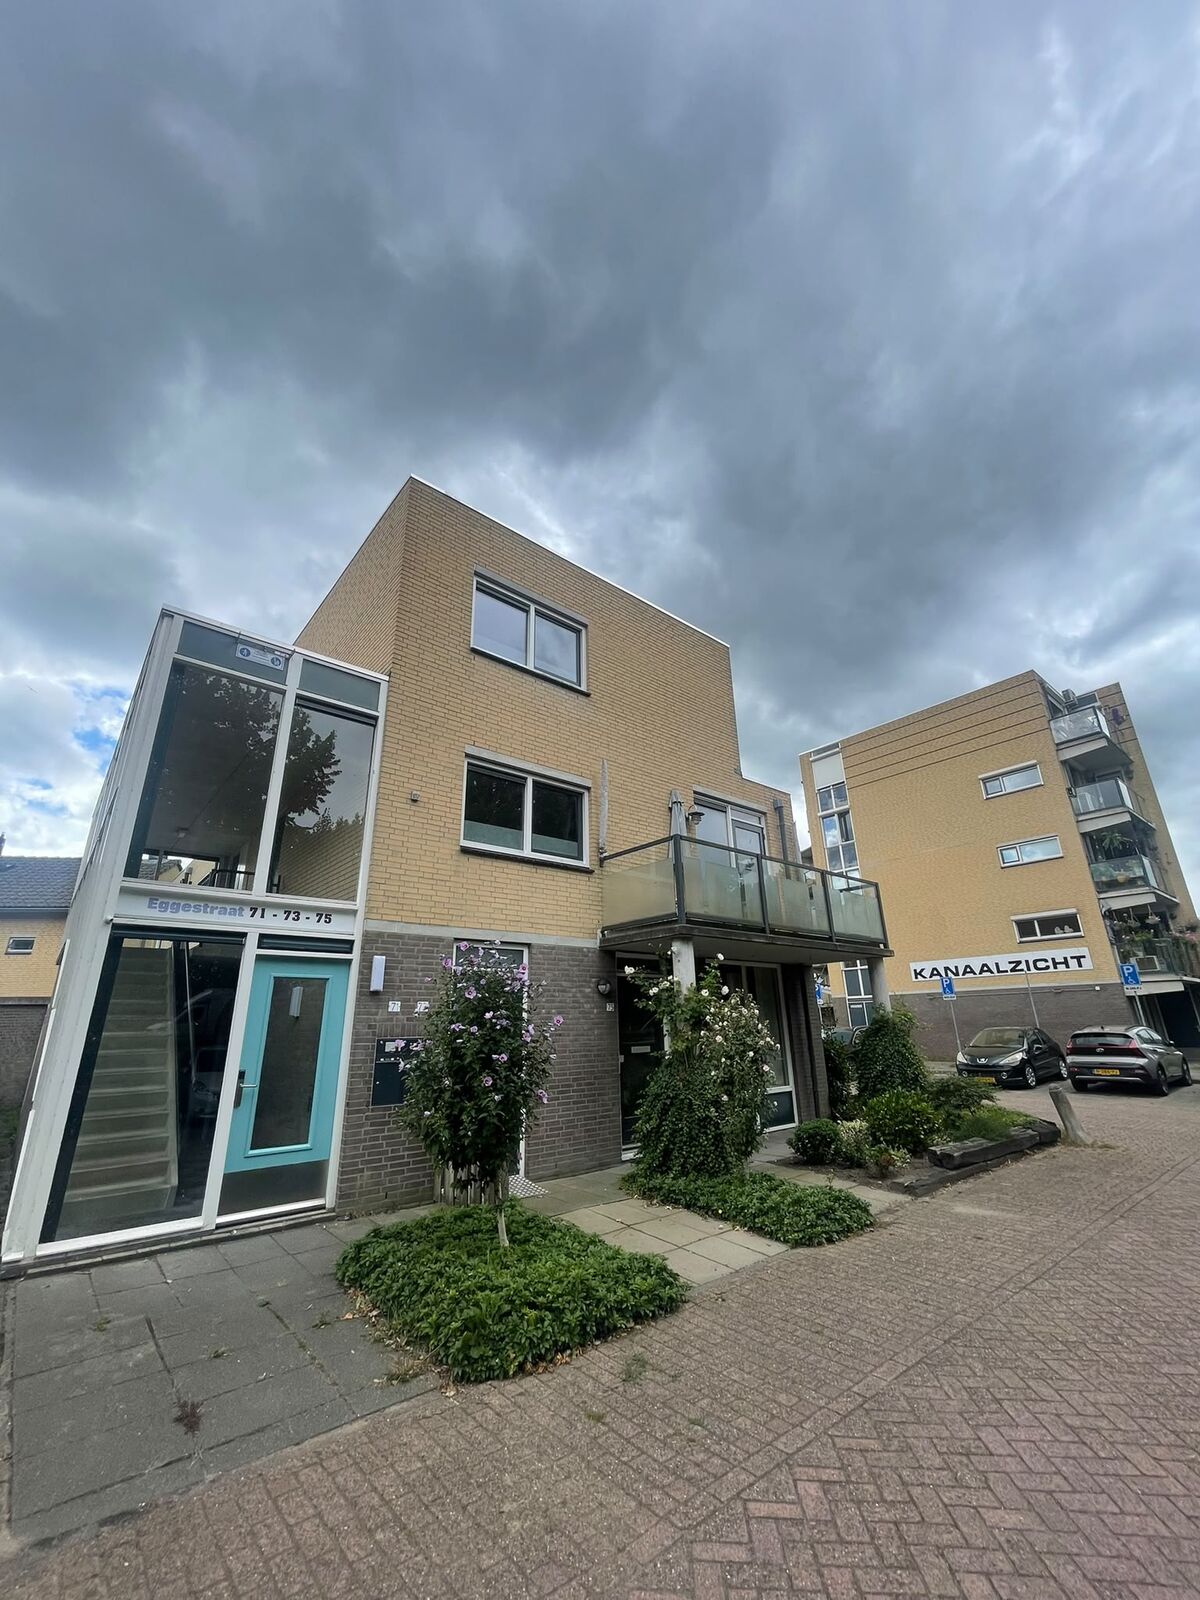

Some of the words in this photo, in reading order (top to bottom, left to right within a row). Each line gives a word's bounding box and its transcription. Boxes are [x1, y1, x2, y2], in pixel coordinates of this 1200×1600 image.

[147, 898, 244, 917] Eggestraat
[249, 907, 265, 919] 71
[283, 910, 300, 922] 73
[315, 912, 332, 924] 75
[913, 954, 1087, 980] KANAALZICHT
[1122, 966, 1133, 977] P
[942, 979, 950, 988] P
